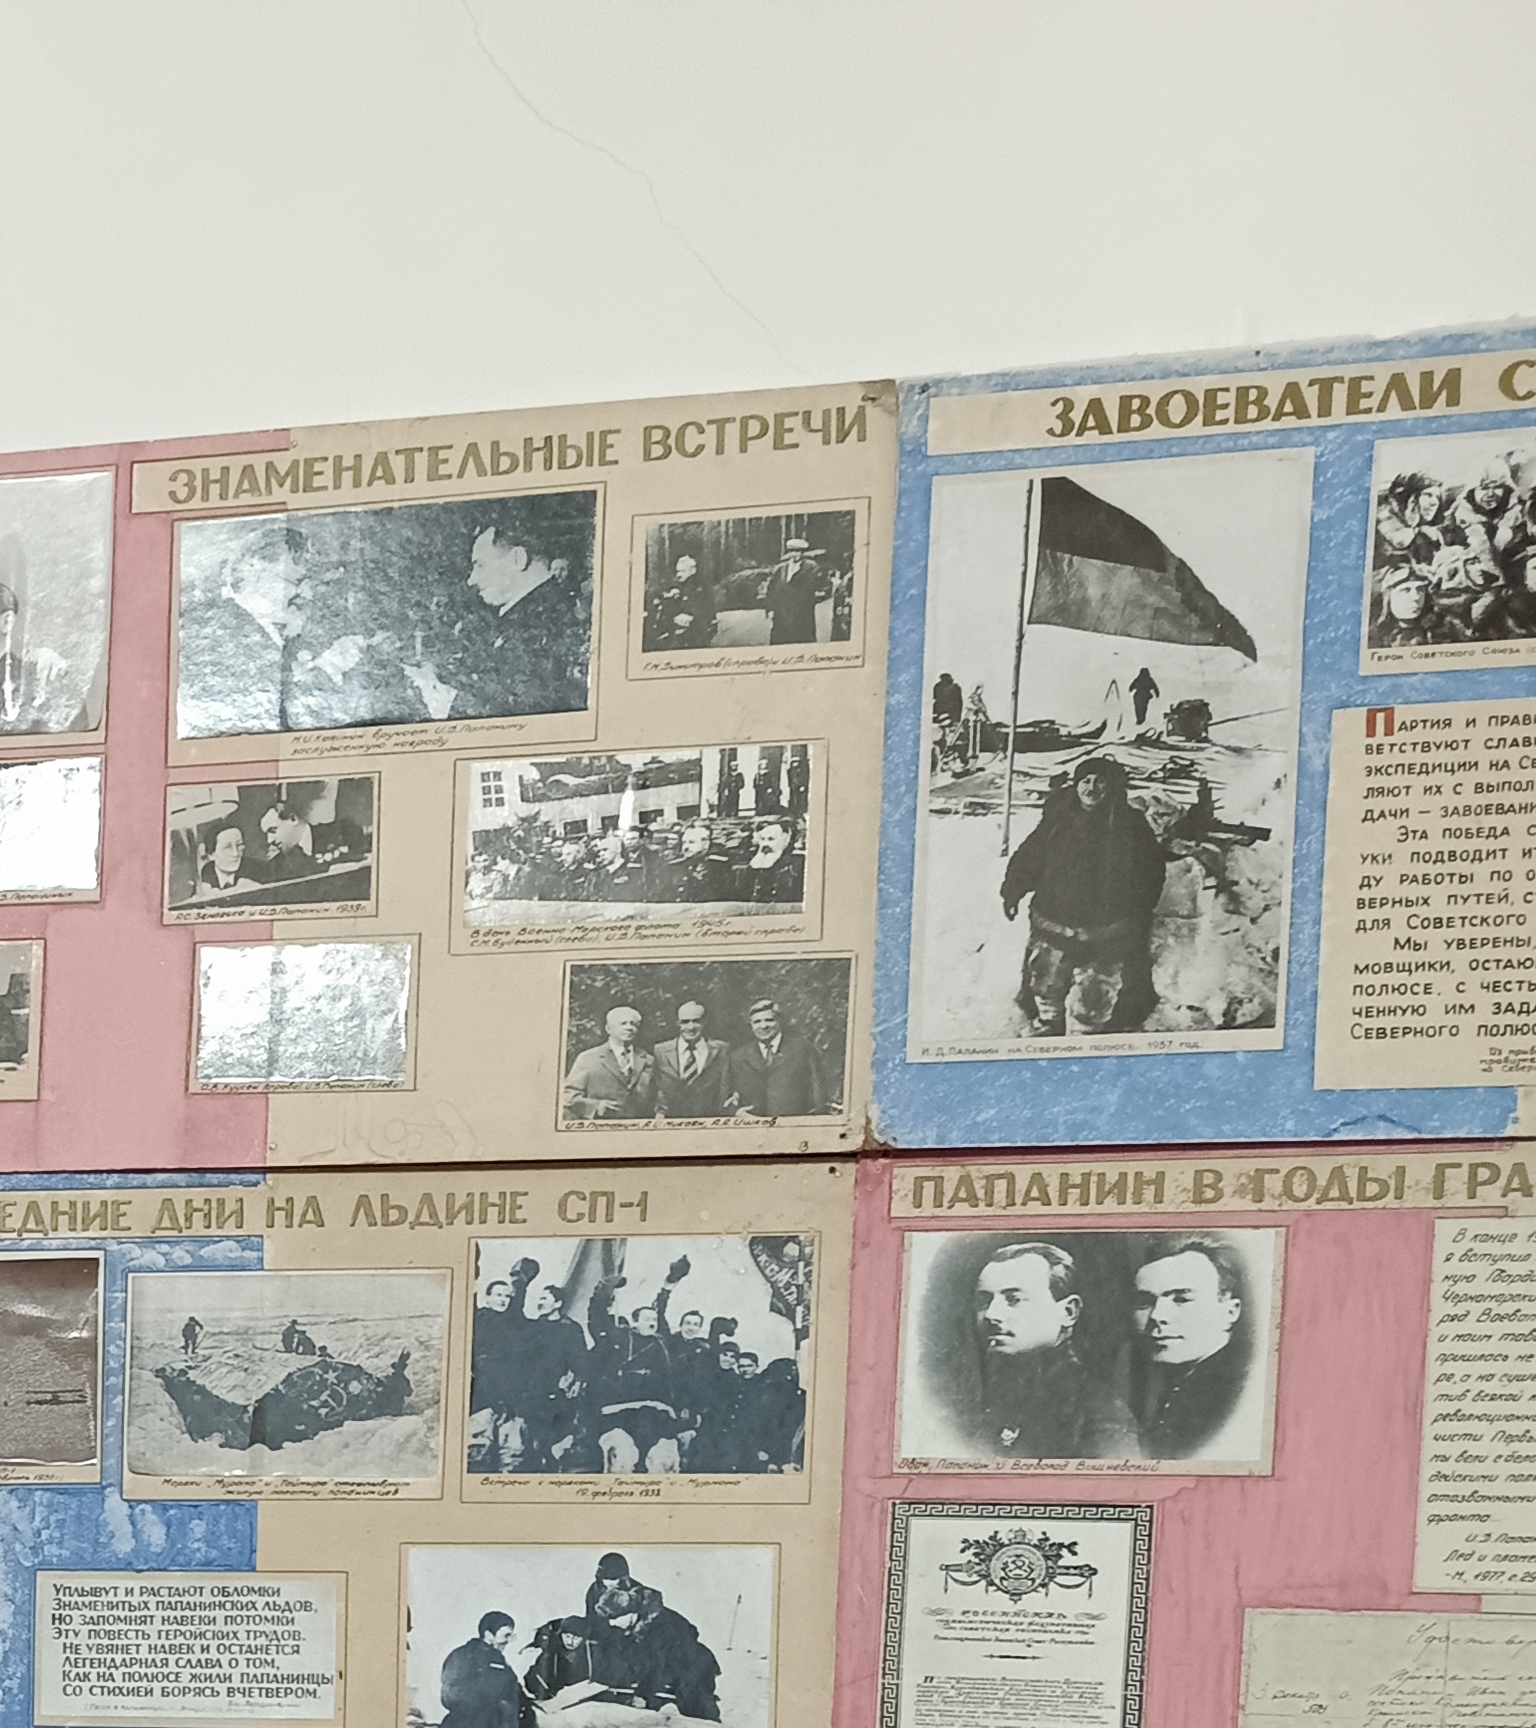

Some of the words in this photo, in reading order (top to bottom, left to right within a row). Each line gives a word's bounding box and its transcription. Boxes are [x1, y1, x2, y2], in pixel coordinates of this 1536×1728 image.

[1046, 367, 1462, 438] ЗАВОЕВАТЕЛИ
[168, 428, 621, 504] ЗНАМЕНАТЕЛЬНЫЕ
[643, 404, 866, 462] ВСТРЕЧИ
[1364, 703, 1453, 738] ПАРТИЯ
[1464, 716, 1477, 729] И
[1364, 738, 1471, 756] ВЕТСТВУЮТ
[1363, 759, 1478, 778] ЭКСПЕДИЦИИ
[1488, 757, 1511, 771] НА
[1362, 784, 1411, 800] ЛЯЮТ
[1423, 783, 1443, 796] ИХ
[1452, 782, 1462, 795] С
[1361, 806, 1409, 823] ДАЧИ
[1396, 824, 1428, 843] ЭТА
[1442, 825, 1511, 841] ПОБЕДА
[1410, 846, 1508, 864] ПОДВОДИТ
[1358, 874, 1383, 890] ДУ
[1399, 870, 1474, 887] РАБОТЫ
[1489, 868, 1512, 883] ПО
[1356, 894, 1430, 910] ВЕРНЫХ
[1446, 886, 1514, 908] ПУТЕЙ,
[1355, 917, 1391, 934] ДЛЯ
[1406, 908, 1527, 931] СОВЕТСКОГО
[1392, 935, 1427, 952] МЫ
[1353, 958, 1455, 978] МОВЩИКИ,
[1455, 980, 1466, 994] С
[1351, 1003, 1427, 1020] ЧЕННУЮ
[1444, 1002, 1475, 1016] ИМ
[1349, 1017, 1459, 1041] СЕВЕРНОГО
[912, 1171, 1165, 1209] ПАПАНИН
[1192, 1169, 1224, 1203] В
[1250, 1166, 1406, 1204] ГОДЫ
[1433, 1162, 1533, 1200] ГРА
[151, 1199, 245, 1235] ДНИ
[265, 1195, 324, 1230] НА
[350, 1191, 529, 1230] ЛЬДИНЕ
[558, 1190, 649, 1224] СП-1
[1451, 1227, 1468, 1243] В
[1469, 1232, 1518, 1246] конце
[52, 1583, 120, 1599] УПЛЫВУТ
[124, 1586, 134, 1597] И
[139, 1584, 204, 1600] РАСТАЮТ
[209, 1584, 281, 1600] ОБЛОМКИ
[51, 1597, 151, 1613] ЗНАМЕНИТЫХ
[155, 1598, 258, 1614] ПАПАНИНСКИХ
[261, 1599, 318, 1615] ЛЬДОВ,
[51, 1613, 73, 1625] НО
[78, 1613, 155, 1627] ЗАПОМНЯТ
[160, 1613, 217, 1626] НАВЕКИ
[223, 1613, 295, 1627] ПОТОМКИ
[51, 1627, 81, 1640] ЭТУ
[87, 1628, 151, 1641] ПОВЕСТЬ
[156, 1626, 240, 1642] ГЕРОЙСКИХ
[244, 1629, 306, 1643] ТРУДОВ.
[62, 1642, 82, 1655] НЕ
[85, 1642, 142, 1656] УВЯНЕТ
[147, 1642, 195, 1655] НАВЕК
[200, 1643, 210, 1654] И
[216, 1642, 300, 1656] ОСТАНЕТСЯ
[61, 1655, 169, 1672] ЛЕГЕНДАРНАЯ
[174, 1657, 223, 1670] СЛАВА
[228, 1657, 239, 1669] О
[244, 1657, 280, 1671] ТОМ,
[61, 1669, 91, 1683] КАК
[96, 1670, 115, 1682] НА
[121, 1670, 182, 1683] ПОЛЮСЕ
[188, 1671, 233, 1683] ЖИЛИ
[239, 1671, 334, 1687] ПАПАНИНЦЫ
[62, 1683, 82, 1696] СО
[88, 1682, 153, 1697] СТИХИЕЙ
[160, 1685, 220, 1698] БОРЯСЬ
[226, 1685, 321, 1700] ВЧЕТВЕРОМ.
